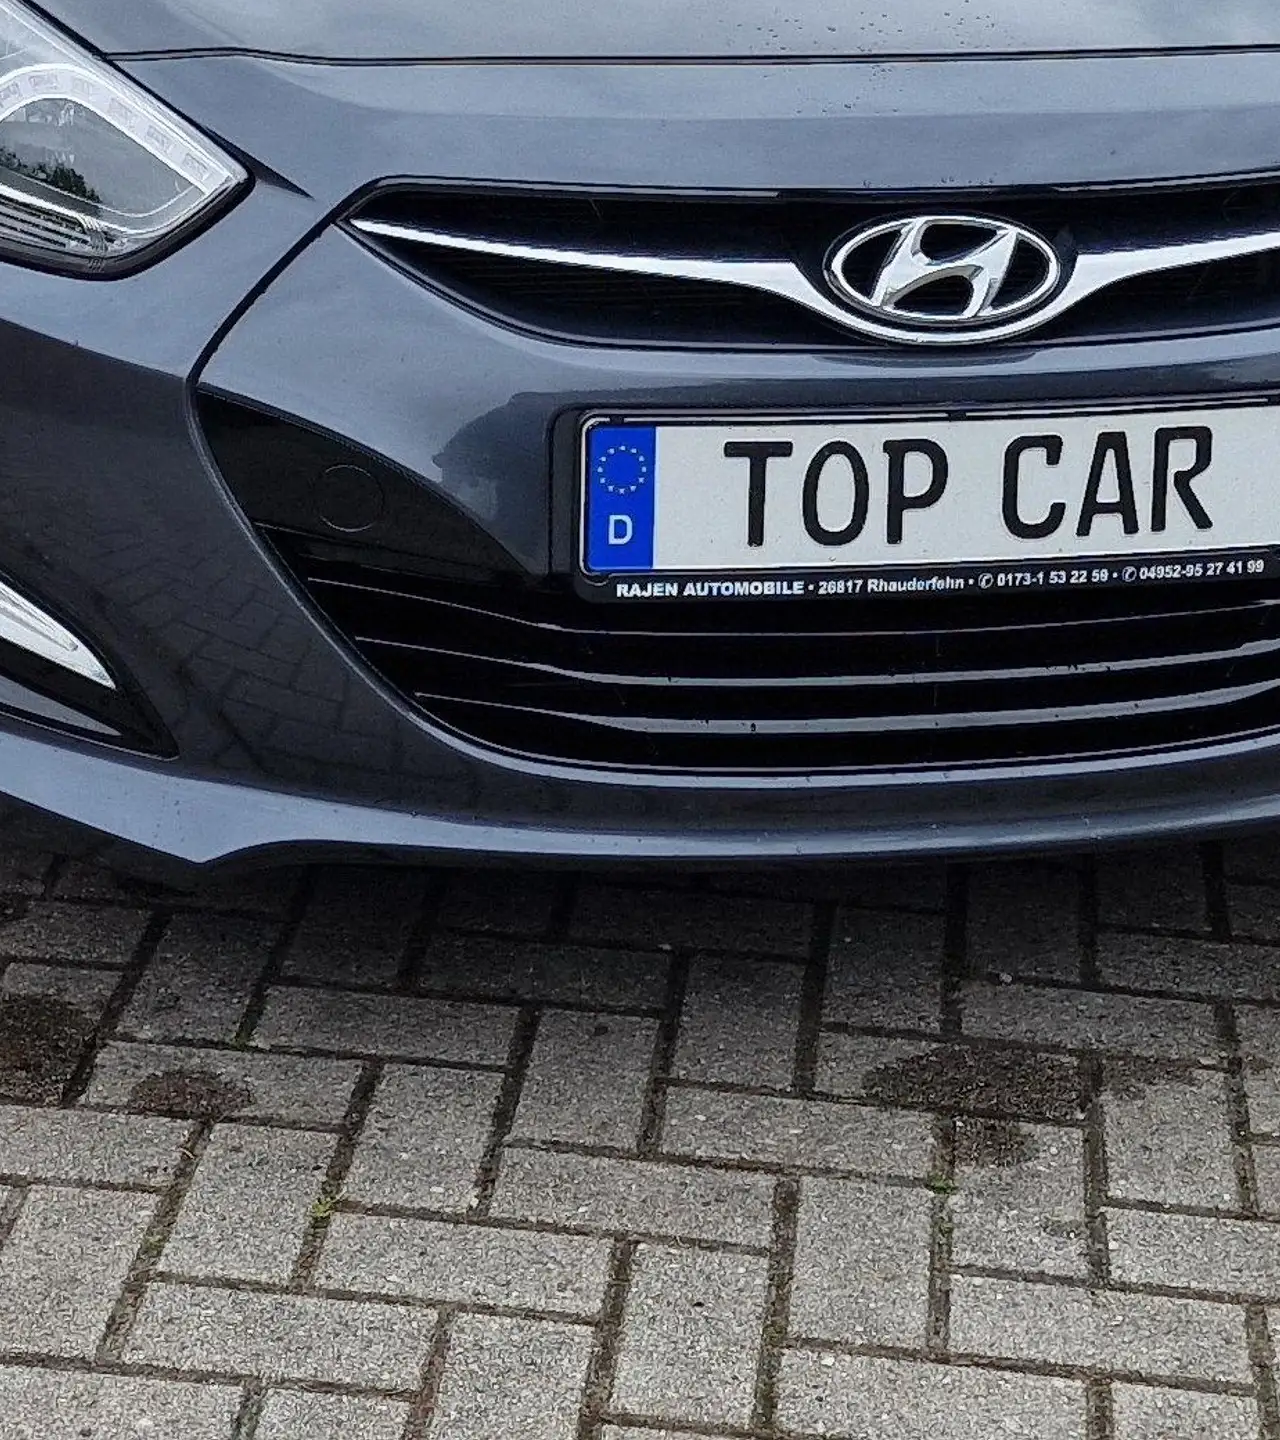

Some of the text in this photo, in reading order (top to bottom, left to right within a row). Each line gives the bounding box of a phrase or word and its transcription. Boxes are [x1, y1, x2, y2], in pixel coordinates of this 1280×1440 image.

[723, 425, 1213, 547] TOP CAR
[607, 514, 634, 545] D
[616, 582, 679, 598] RAJEN
[683, 580, 805, 597] AUTOMOBILE
[817, 578, 863, 595] 26817
[867, 575, 964, 593] Rhauderfehn
[1049, 570, 1067, 584] 53
[1070, 569, 1088, 584] 22
[1139, 563, 1203, 580] 04952-95
[1206, 561, 1224, 576] 27
[1226, 560, 1243, 574] 41
